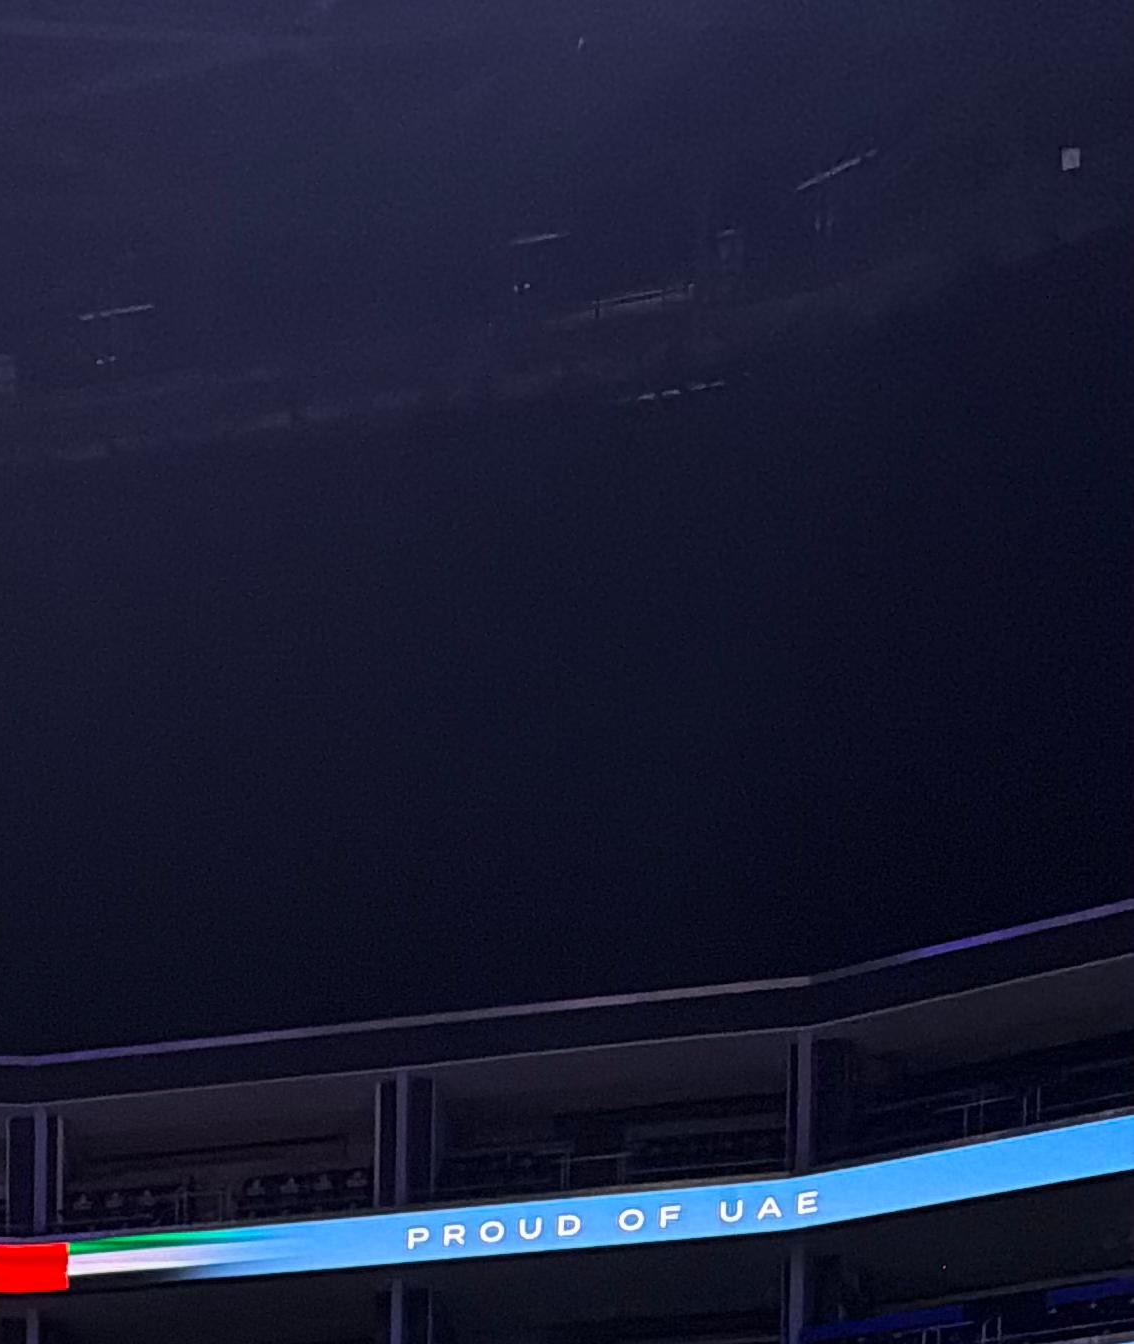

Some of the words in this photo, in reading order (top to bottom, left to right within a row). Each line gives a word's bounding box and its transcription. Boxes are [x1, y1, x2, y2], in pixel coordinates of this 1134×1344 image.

[407, 1214, 581, 1250] PROUD
[618, 1205, 681, 1232] OF
[719, 1190, 819, 1223] UAE
